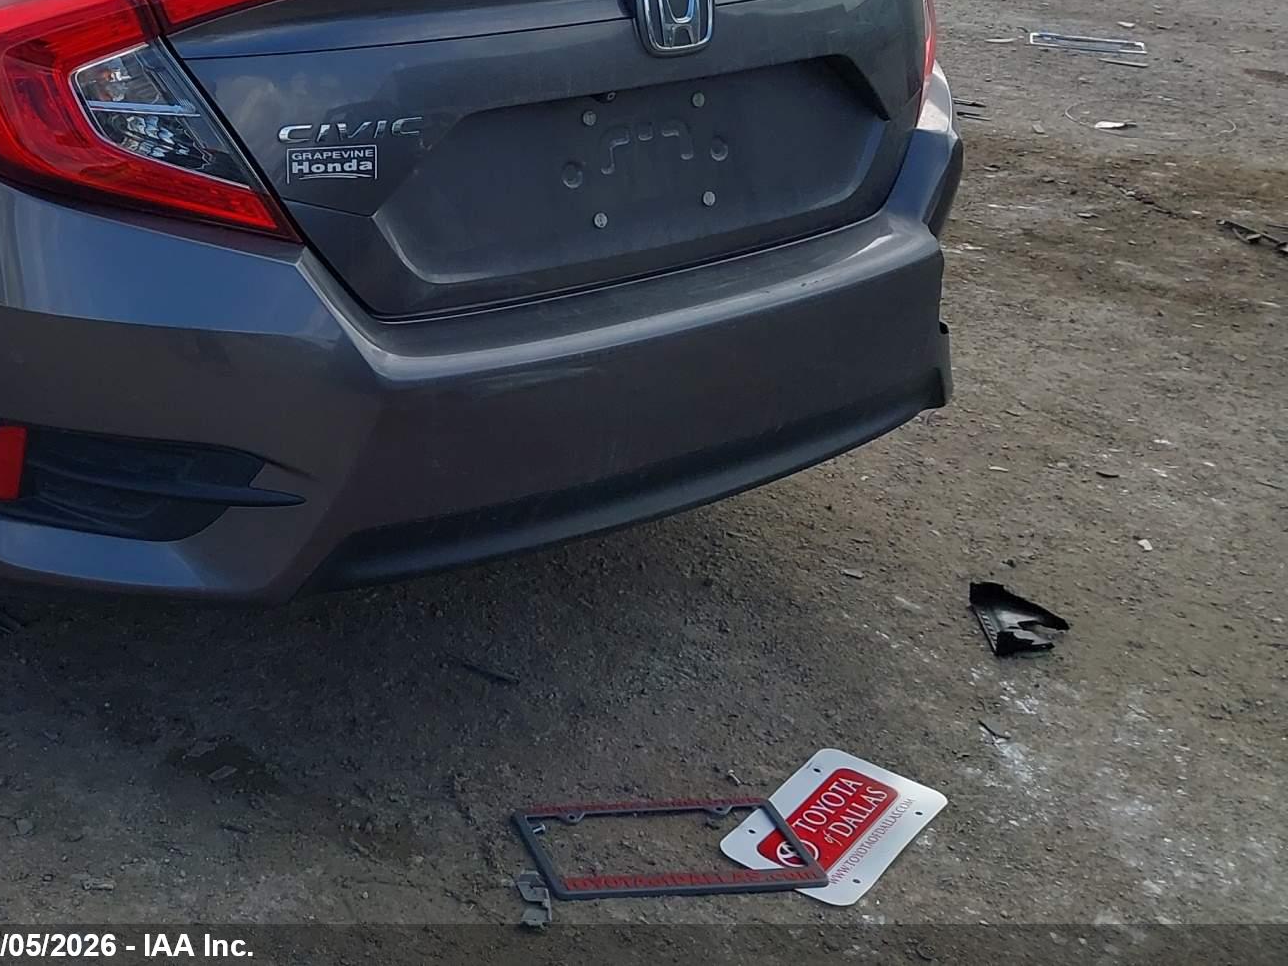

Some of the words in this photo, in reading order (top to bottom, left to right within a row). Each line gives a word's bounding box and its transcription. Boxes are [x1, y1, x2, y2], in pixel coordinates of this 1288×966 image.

[278, 116, 423, 144] CIVIC
[291, 149, 374, 160] GRAPEVINE
[291, 158, 373, 174] Honda
[792, 777, 864, 833] TOYOTA
[828, 786, 888, 838] DALLAS
